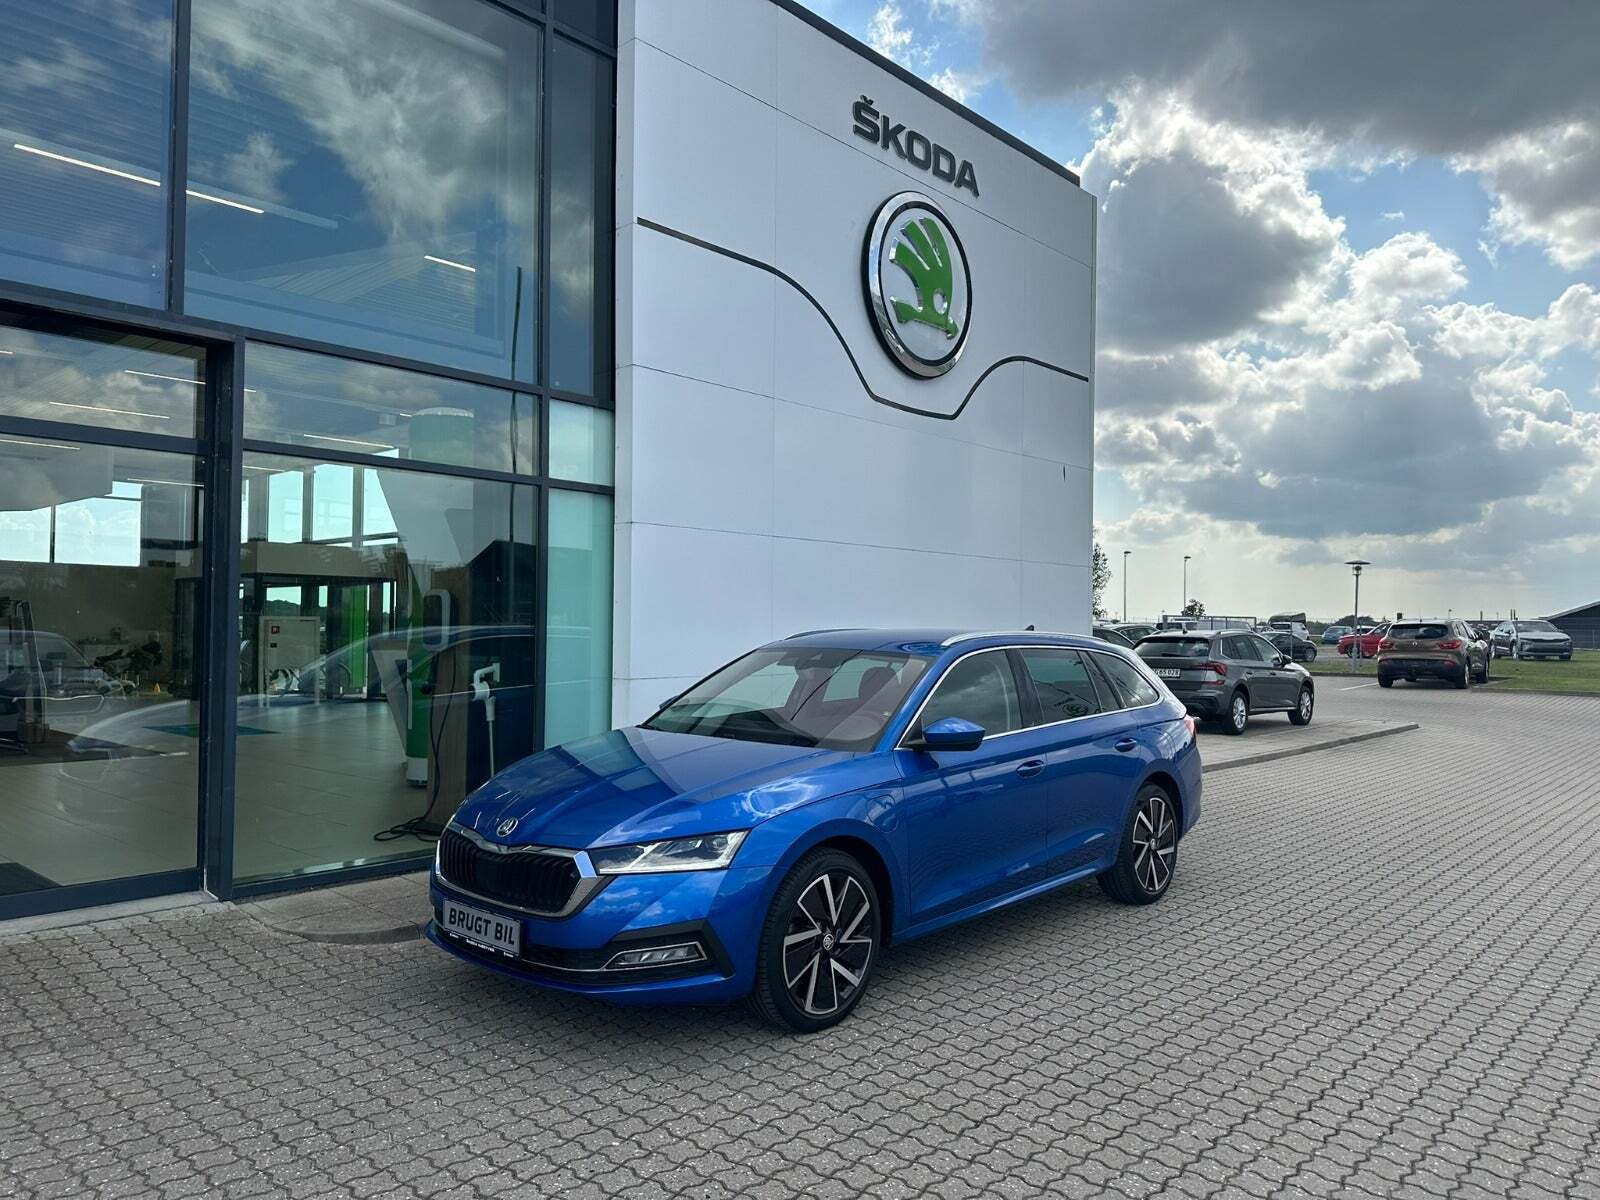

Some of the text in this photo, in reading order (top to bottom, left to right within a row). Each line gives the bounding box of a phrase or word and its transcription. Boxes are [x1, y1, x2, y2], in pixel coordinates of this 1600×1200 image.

[852, 94, 980, 198] ŠKODA
[448, 907, 515, 945] BRUGT BIL
